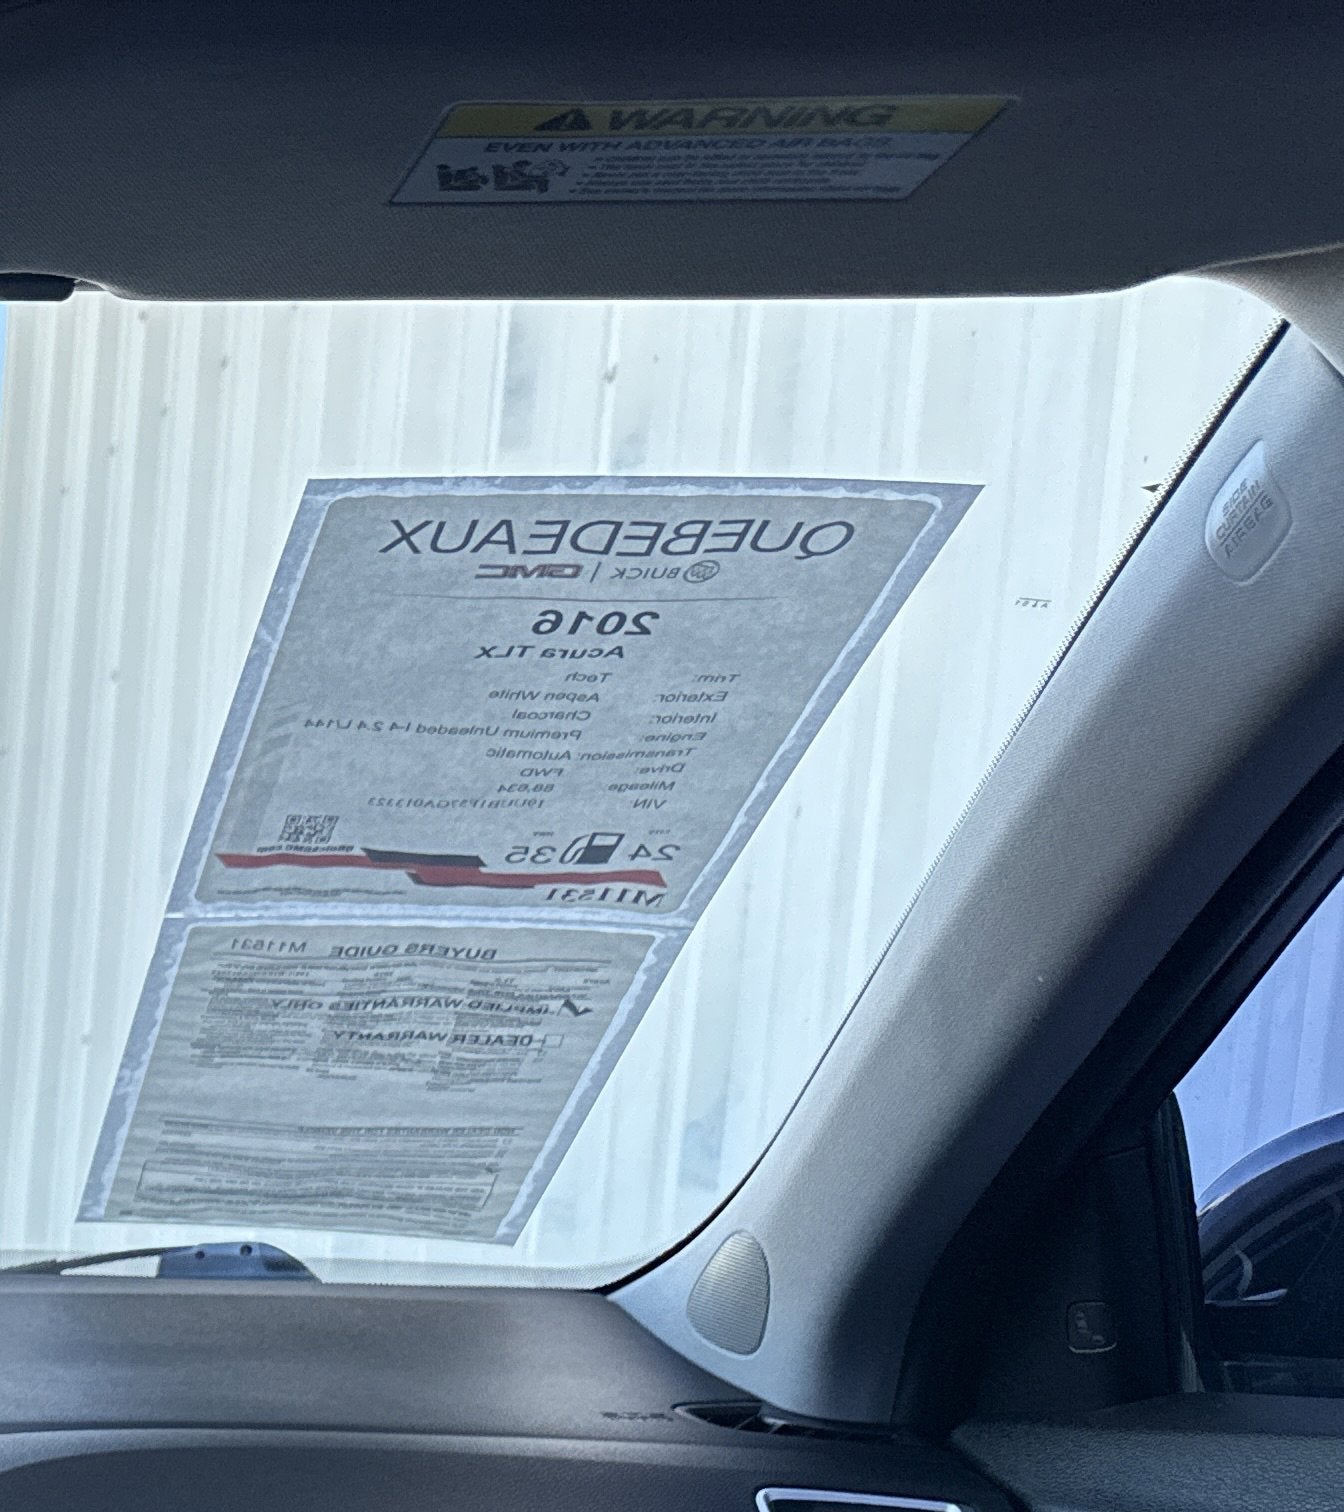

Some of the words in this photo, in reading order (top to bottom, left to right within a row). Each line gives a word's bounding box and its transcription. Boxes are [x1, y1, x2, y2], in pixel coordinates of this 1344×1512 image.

[610, 103, 900, 130] WARNING
[483, 142, 552, 154] EVEN
[625, 138, 767, 153] ADVANCED
